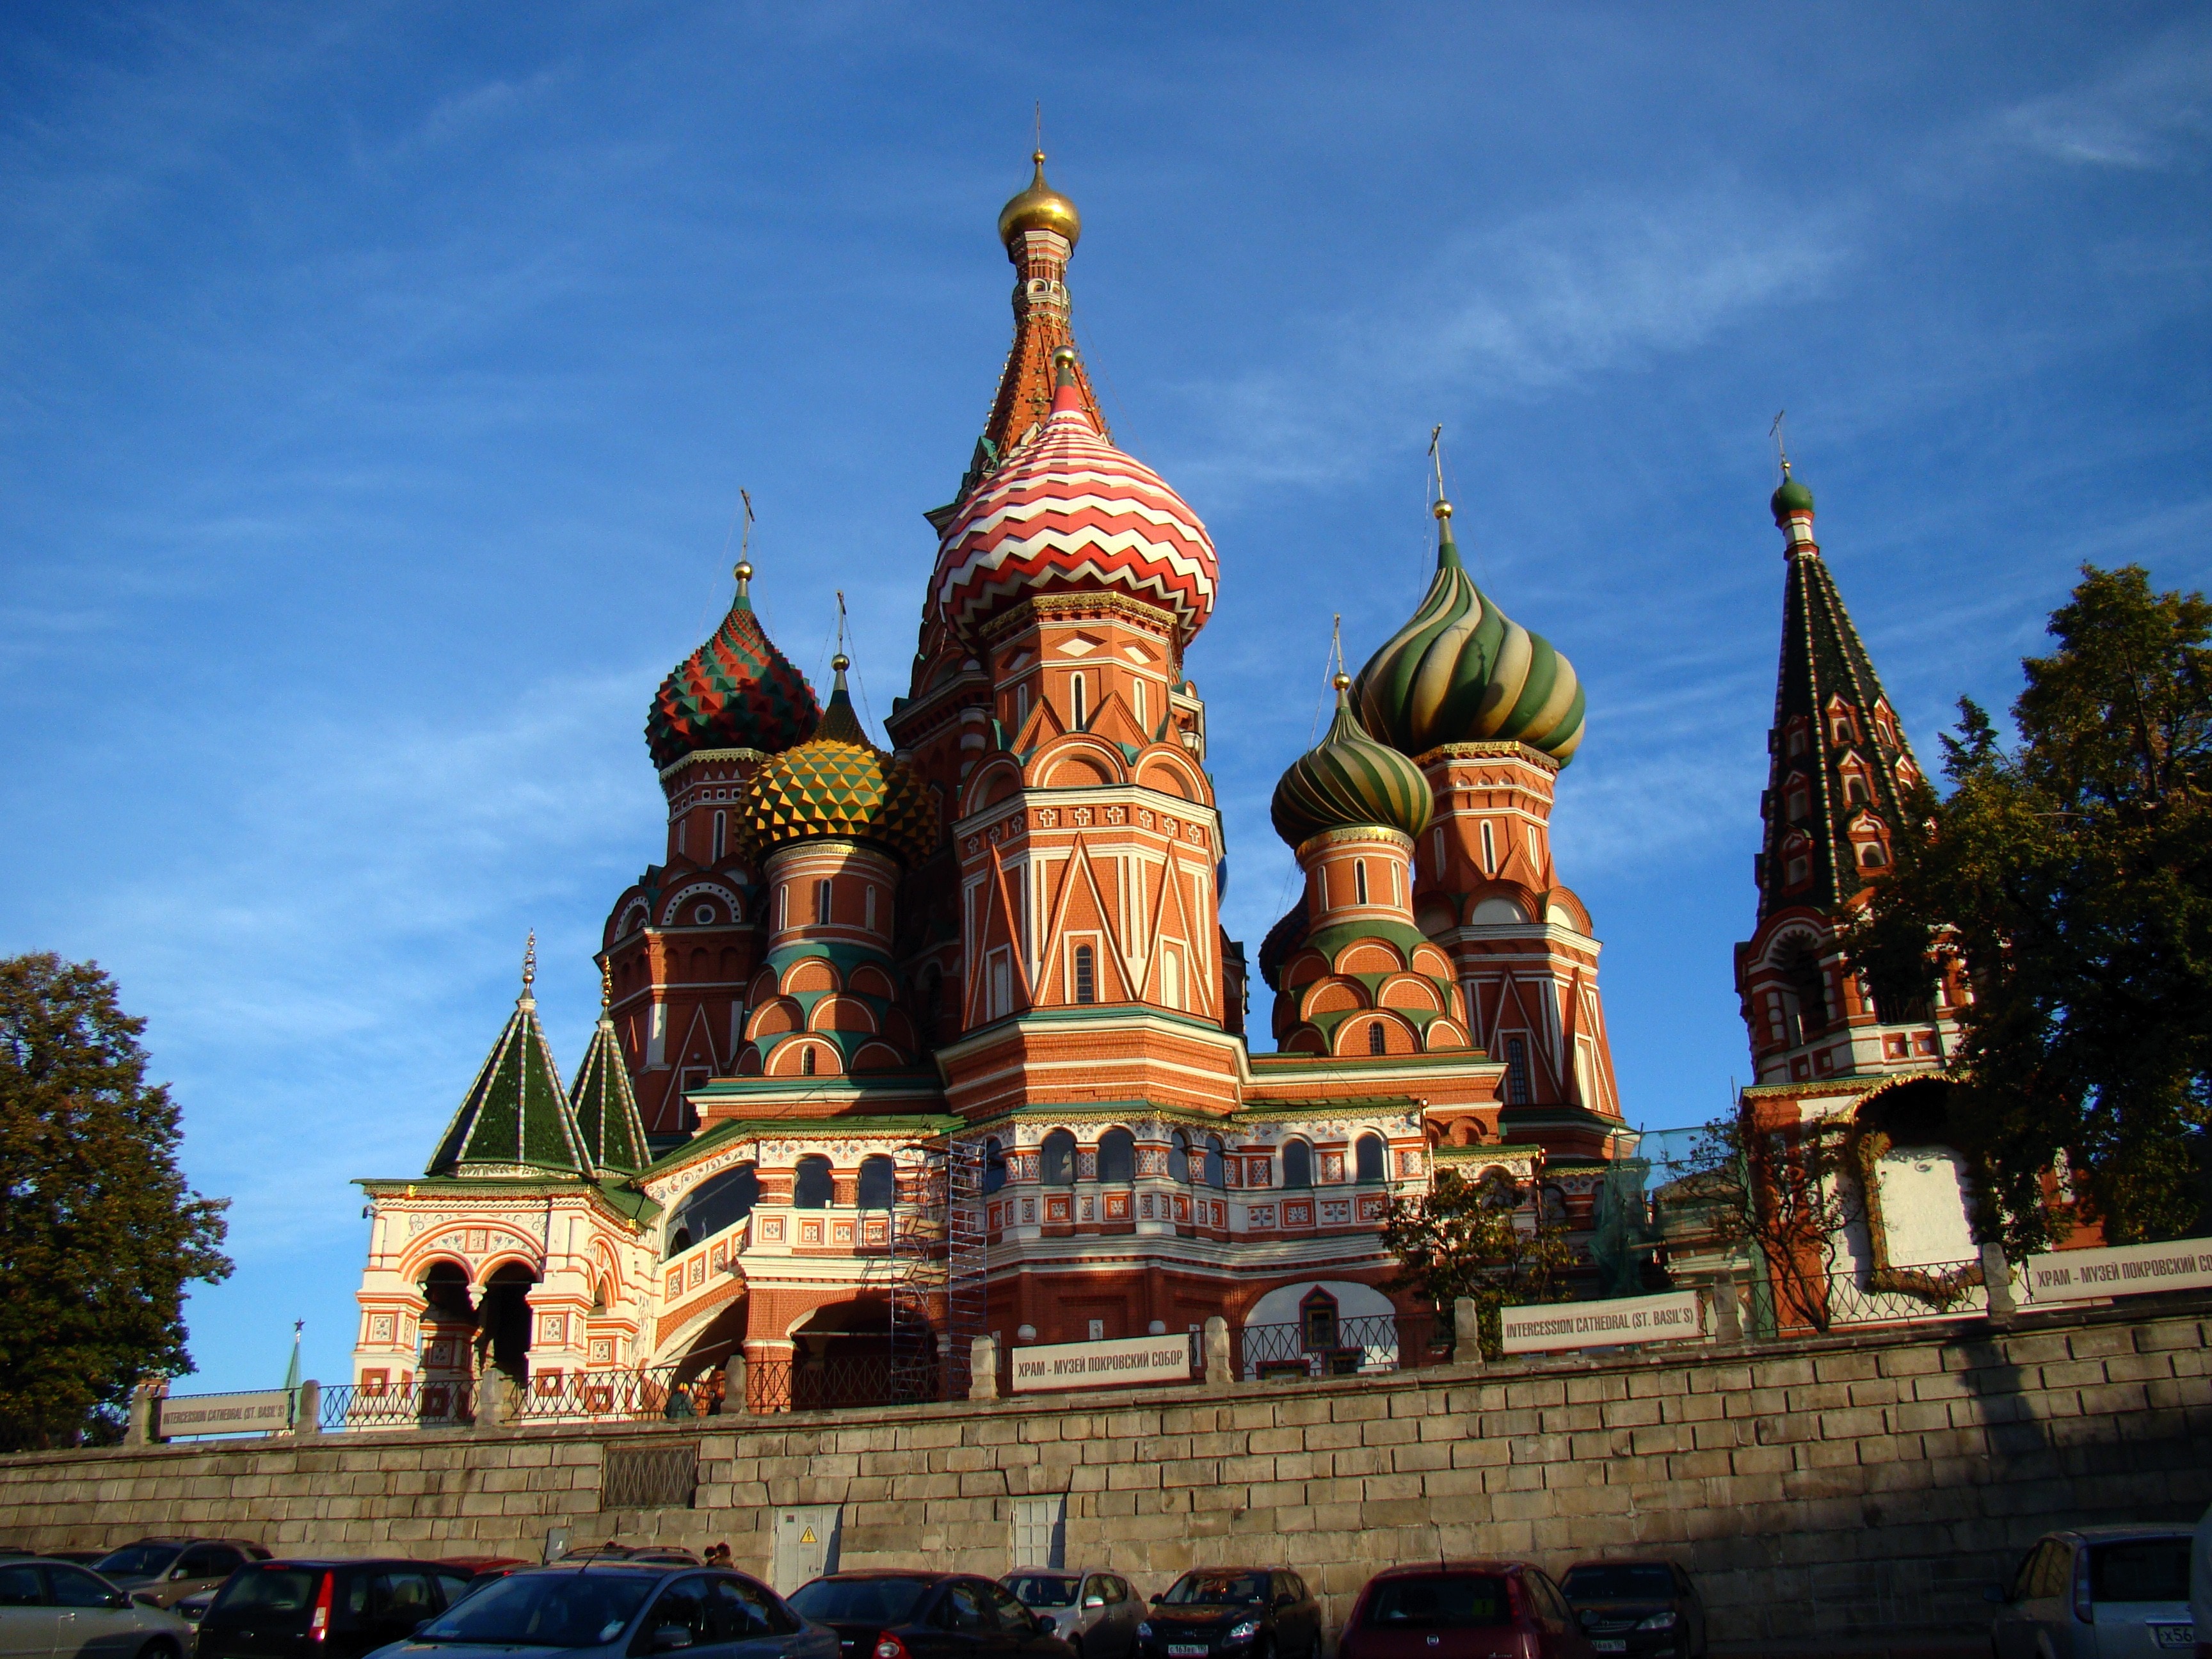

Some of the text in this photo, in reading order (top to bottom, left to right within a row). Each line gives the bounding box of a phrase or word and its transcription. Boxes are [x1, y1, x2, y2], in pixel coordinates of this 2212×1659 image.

[2037, 1268, 2071, 1287] ХРАМ
[2081, 1262, 2120, 1283] МУЗЕЙ
[2122, 1254, 2197, 1278] ПОКРОВСКИЙ
[1506, 1318, 1575, 1338] INTERCESSION
[1576, 1315, 1631, 1333] CATHEDRAL
[1632, 1312, 1651, 1329] (ST.
[1018, 1361, 1045, 1377] ХРАМ
[1054, 1356, 1086, 1375] МУЗЕЙ
[1088, 1352, 1150, 1372] ПОКРОВСКИЙ
[1152, 1349, 1183, 1367] СОБОР
